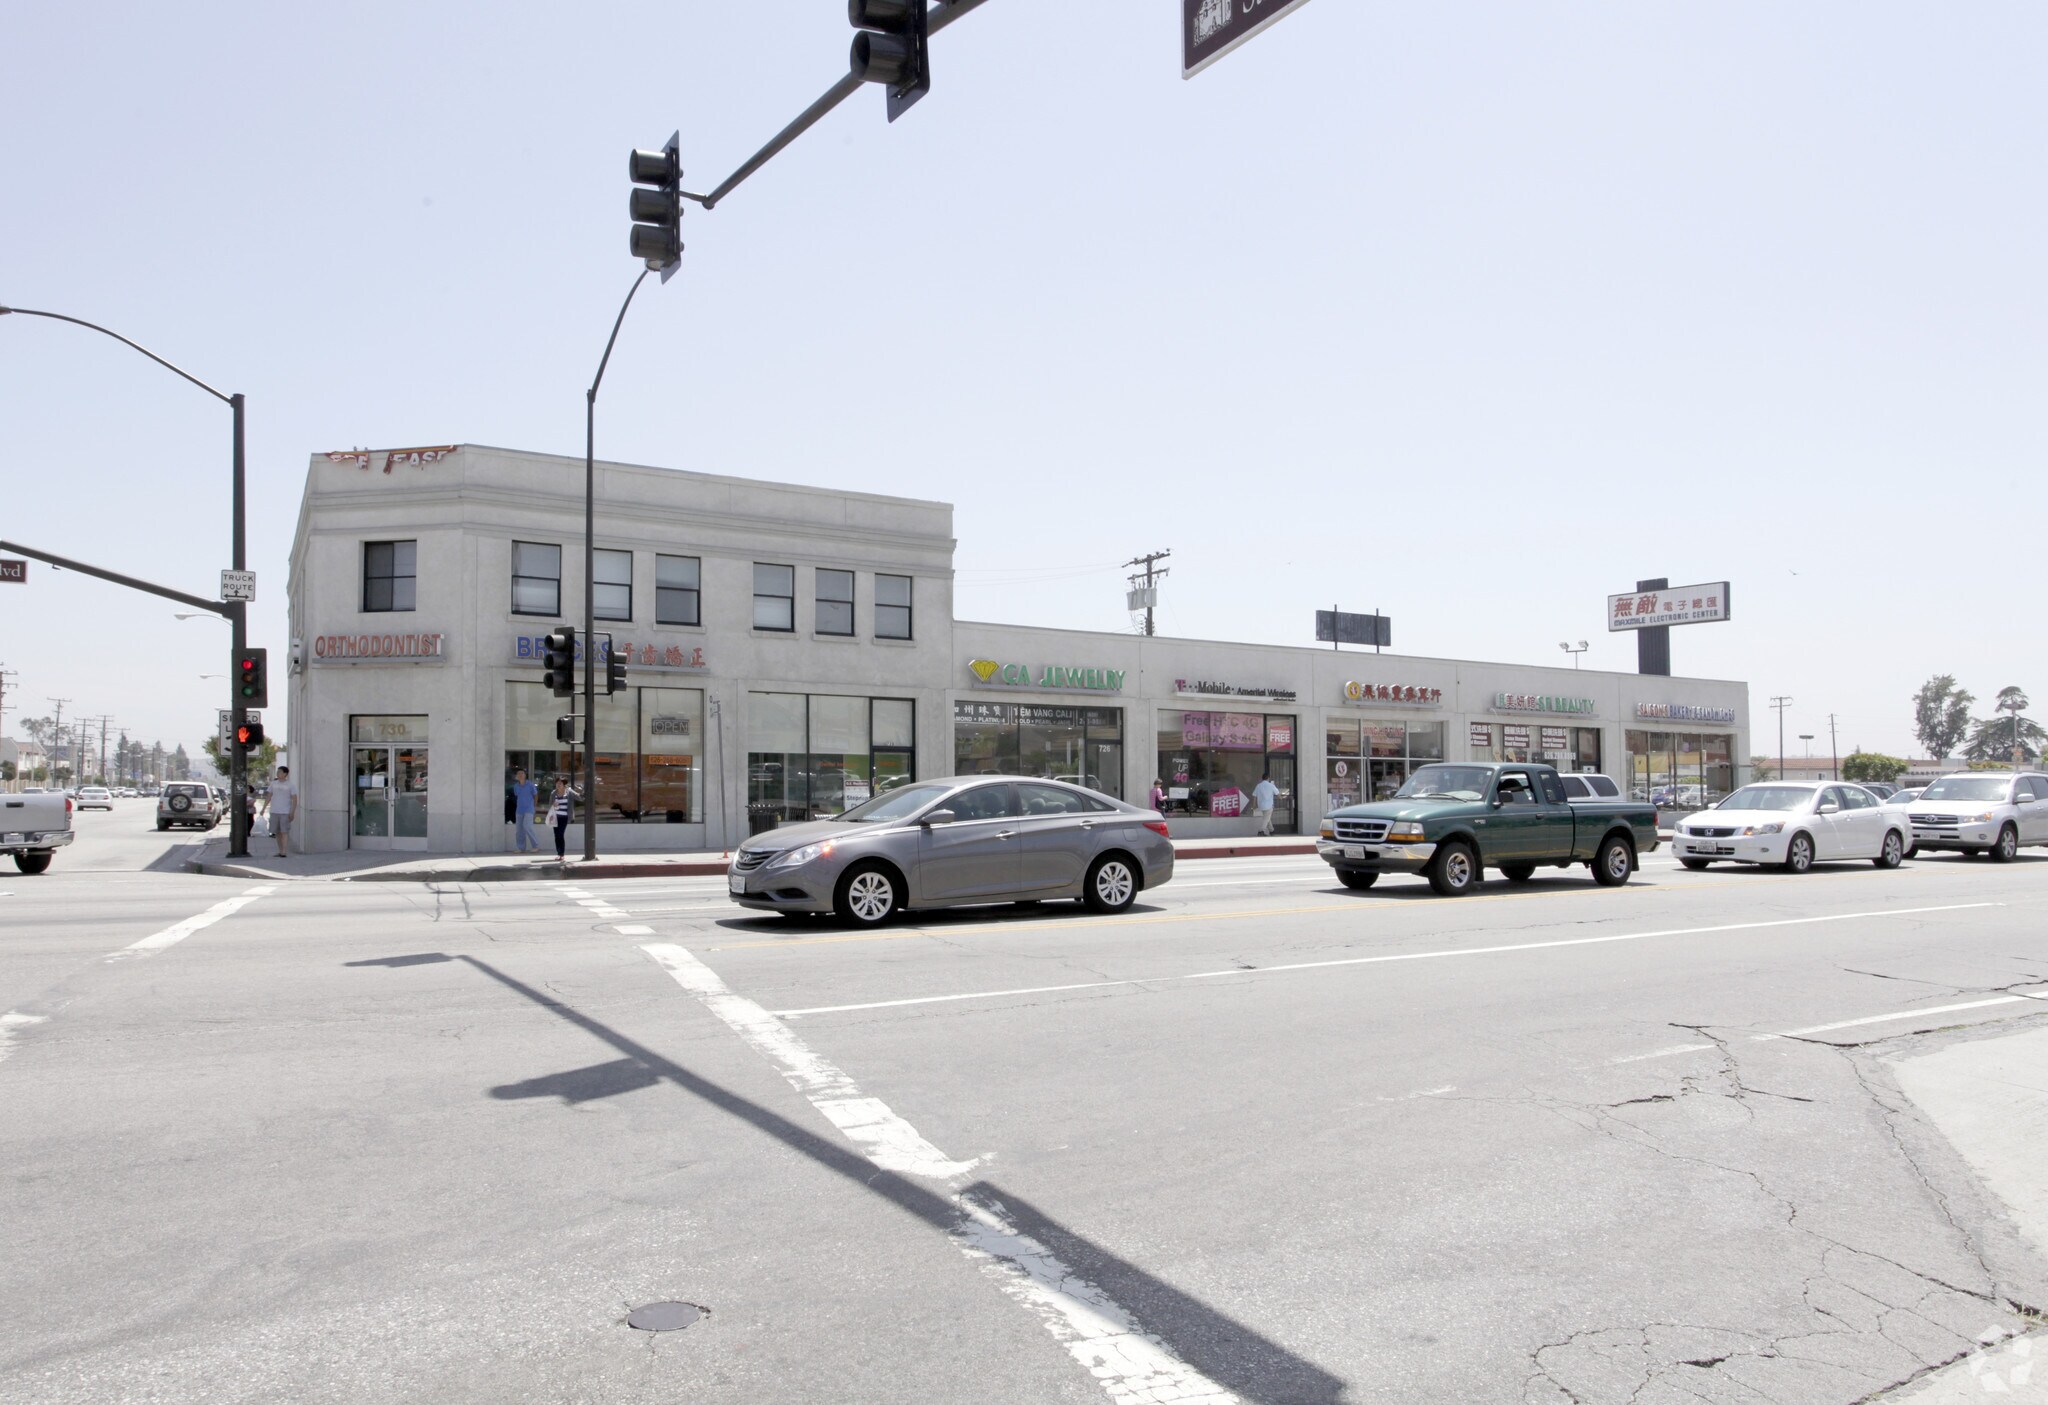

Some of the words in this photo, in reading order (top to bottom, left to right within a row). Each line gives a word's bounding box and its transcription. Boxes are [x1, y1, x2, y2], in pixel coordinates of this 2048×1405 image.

[223, 574, 254, 582] TRUCK
[223, 583, 253, 591] ROUTE
[1649, 612, 1689, 624] ELECTRONIC
[1692, 609, 1719, 619] CENTER
[315, 633, 444, 657] ORTHODONTIST
[1002, 663, 1032, 686] CA
[1040, 666, 1127, 690] JEWELRY
[1267, 688, 1297, 698] Wireless
[1554, 697, 1596, 713] BEAUTY
[655, 720, 688, 734] OPEN
[1183, 713, 1210, 727] Free
[1243, 717, 1259, 729] 4G
[379, 723, 406, 736] 730
[1185, 730, 1226, 746] Galaxy
[1241, 733, 1257, 745] 4G
[1269, 733, 1291, 743] FREE
[1099, 744, 1111, 753] 726
[1178, 763, 1189, 773] UP
[1173, 772, 1189, 783] 4G
[1212, 798, 1239, 812] FREE
